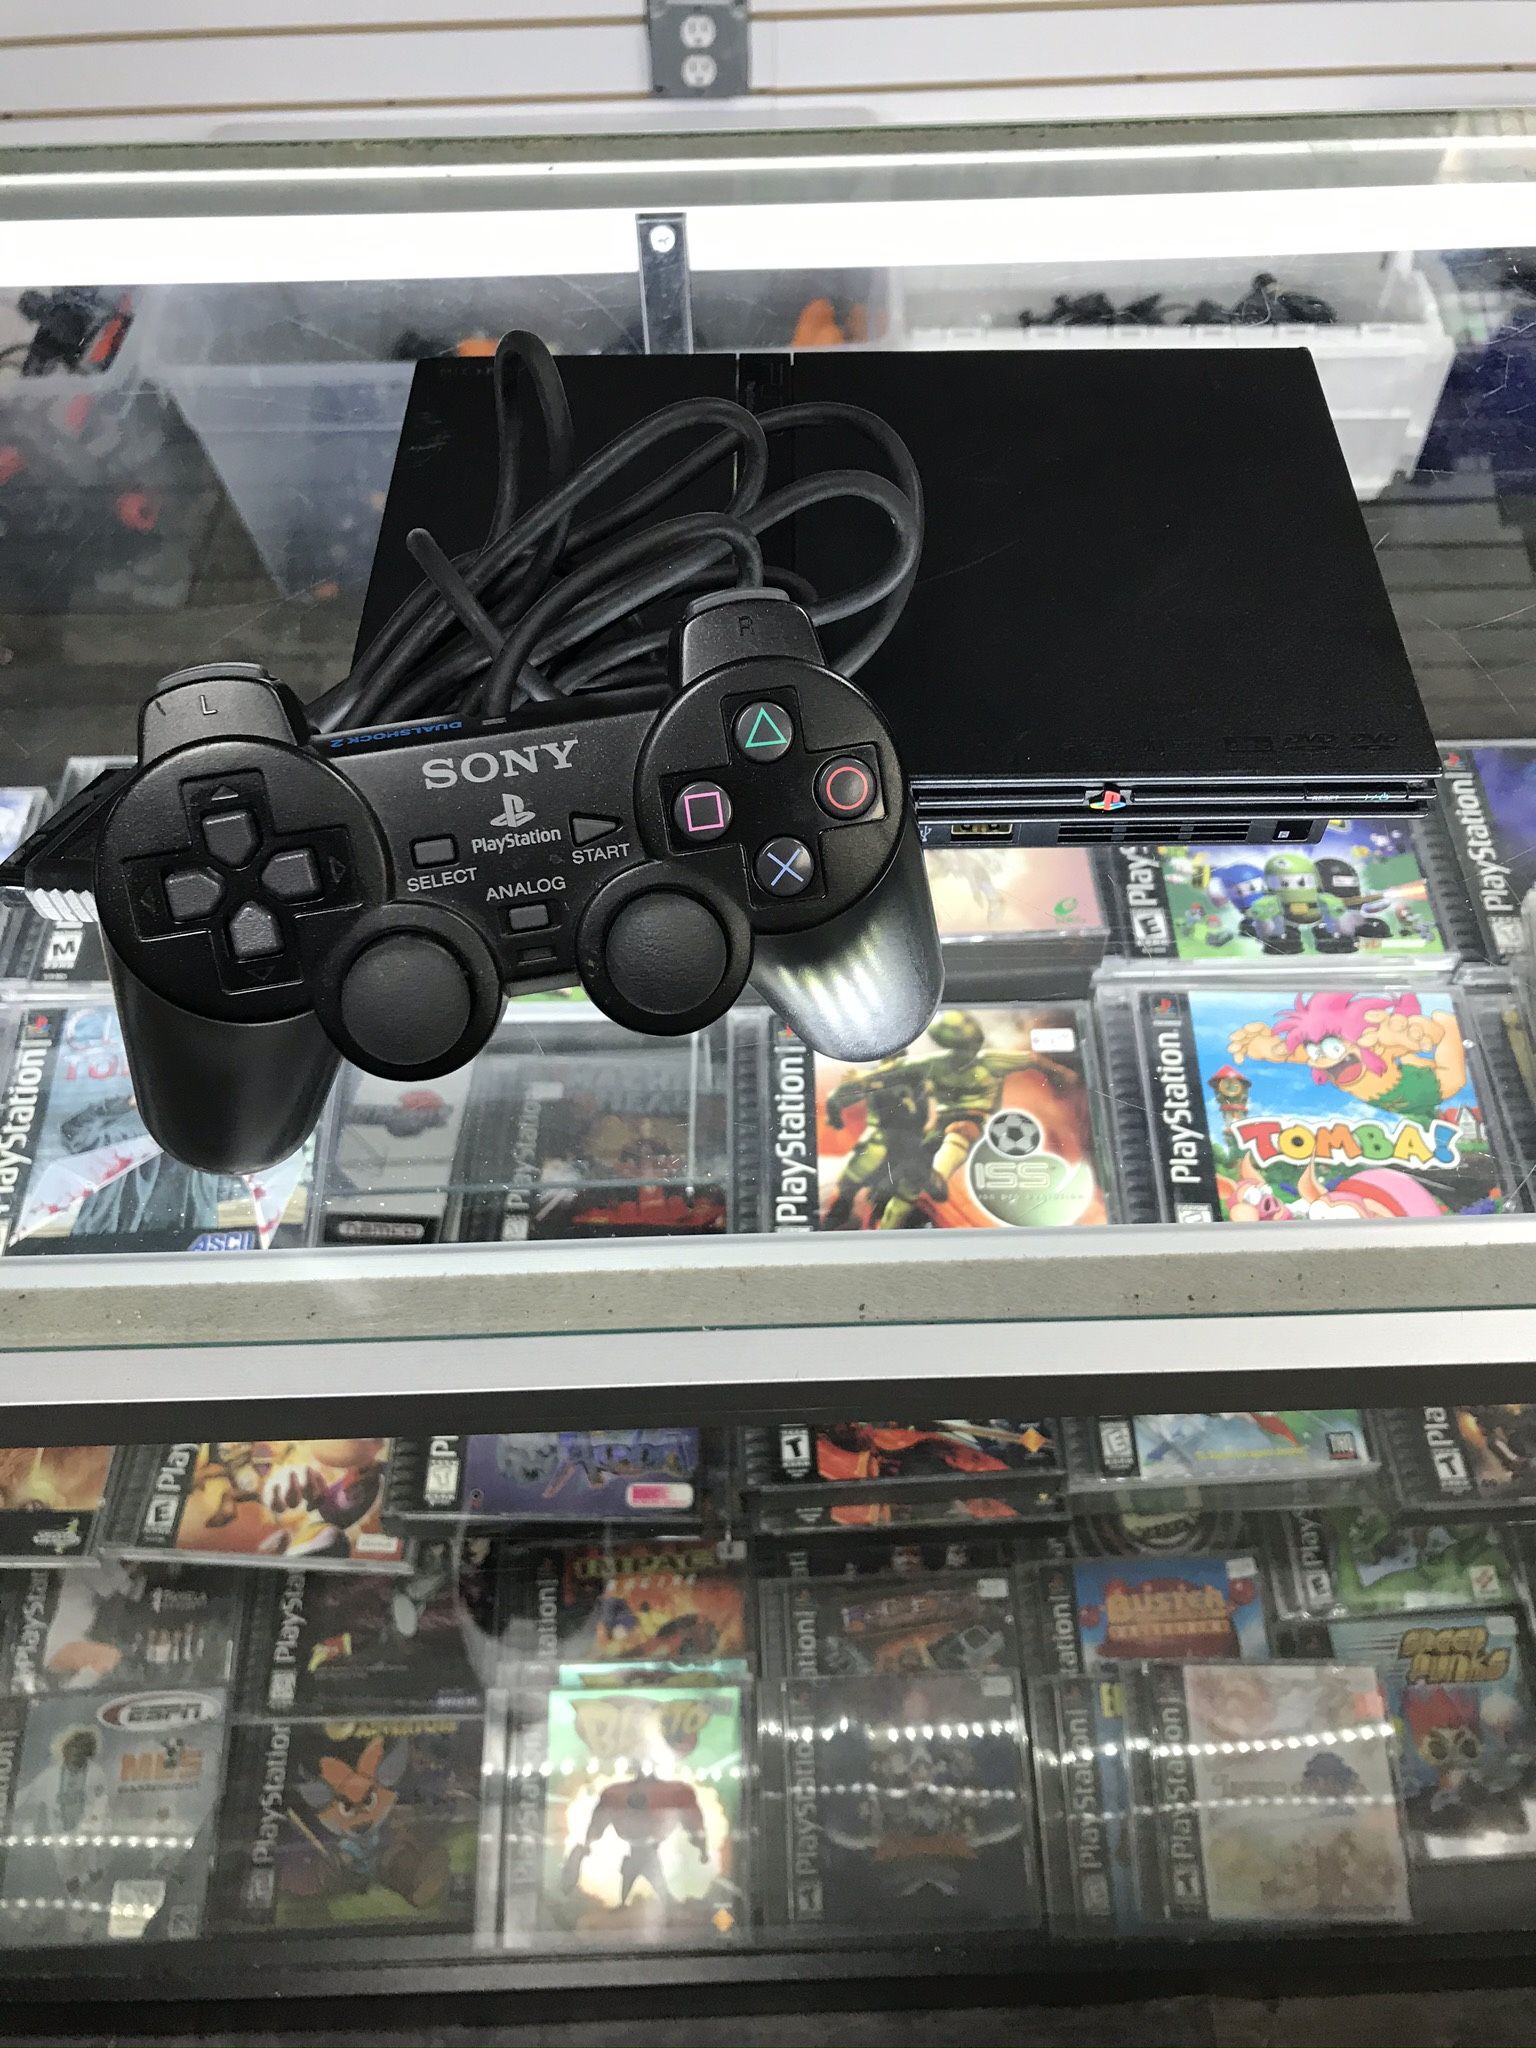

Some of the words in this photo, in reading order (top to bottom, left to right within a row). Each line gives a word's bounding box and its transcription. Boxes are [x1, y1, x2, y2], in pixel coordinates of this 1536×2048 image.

[738, 616, 755, 636] R
[200, 696, 218, 717] L
[329, 736, 346, 748] 2
[347, 720, 464, 747] DUALSHOCK
[422, 739, 579, 790] SONY
[471, 828, 562, 855] PlayStation
[571, 842, 631, 865] START
[1451, 778, 1514, 912] PlayStation
[406, 866, 478, 893] SELECT
[485, 875, 567, 902] ANALOG
[1156, 1031, 1204, 1184] PlayStation
[774, 1055, 818, 1223] PlayStation
[1234, 1117, 1462, 1167] TOMBA!
[505, 1100, 542, 1212] PlayStatio
[974, 1161, 1051, 1190] ISS
[189, 1232, 253, 1252] ASCII
[786, 1438, 801, 1460] T
[127, 1703, 202, 1723] ESPN
[793, 1722, 826, 1876] PlayStatio
